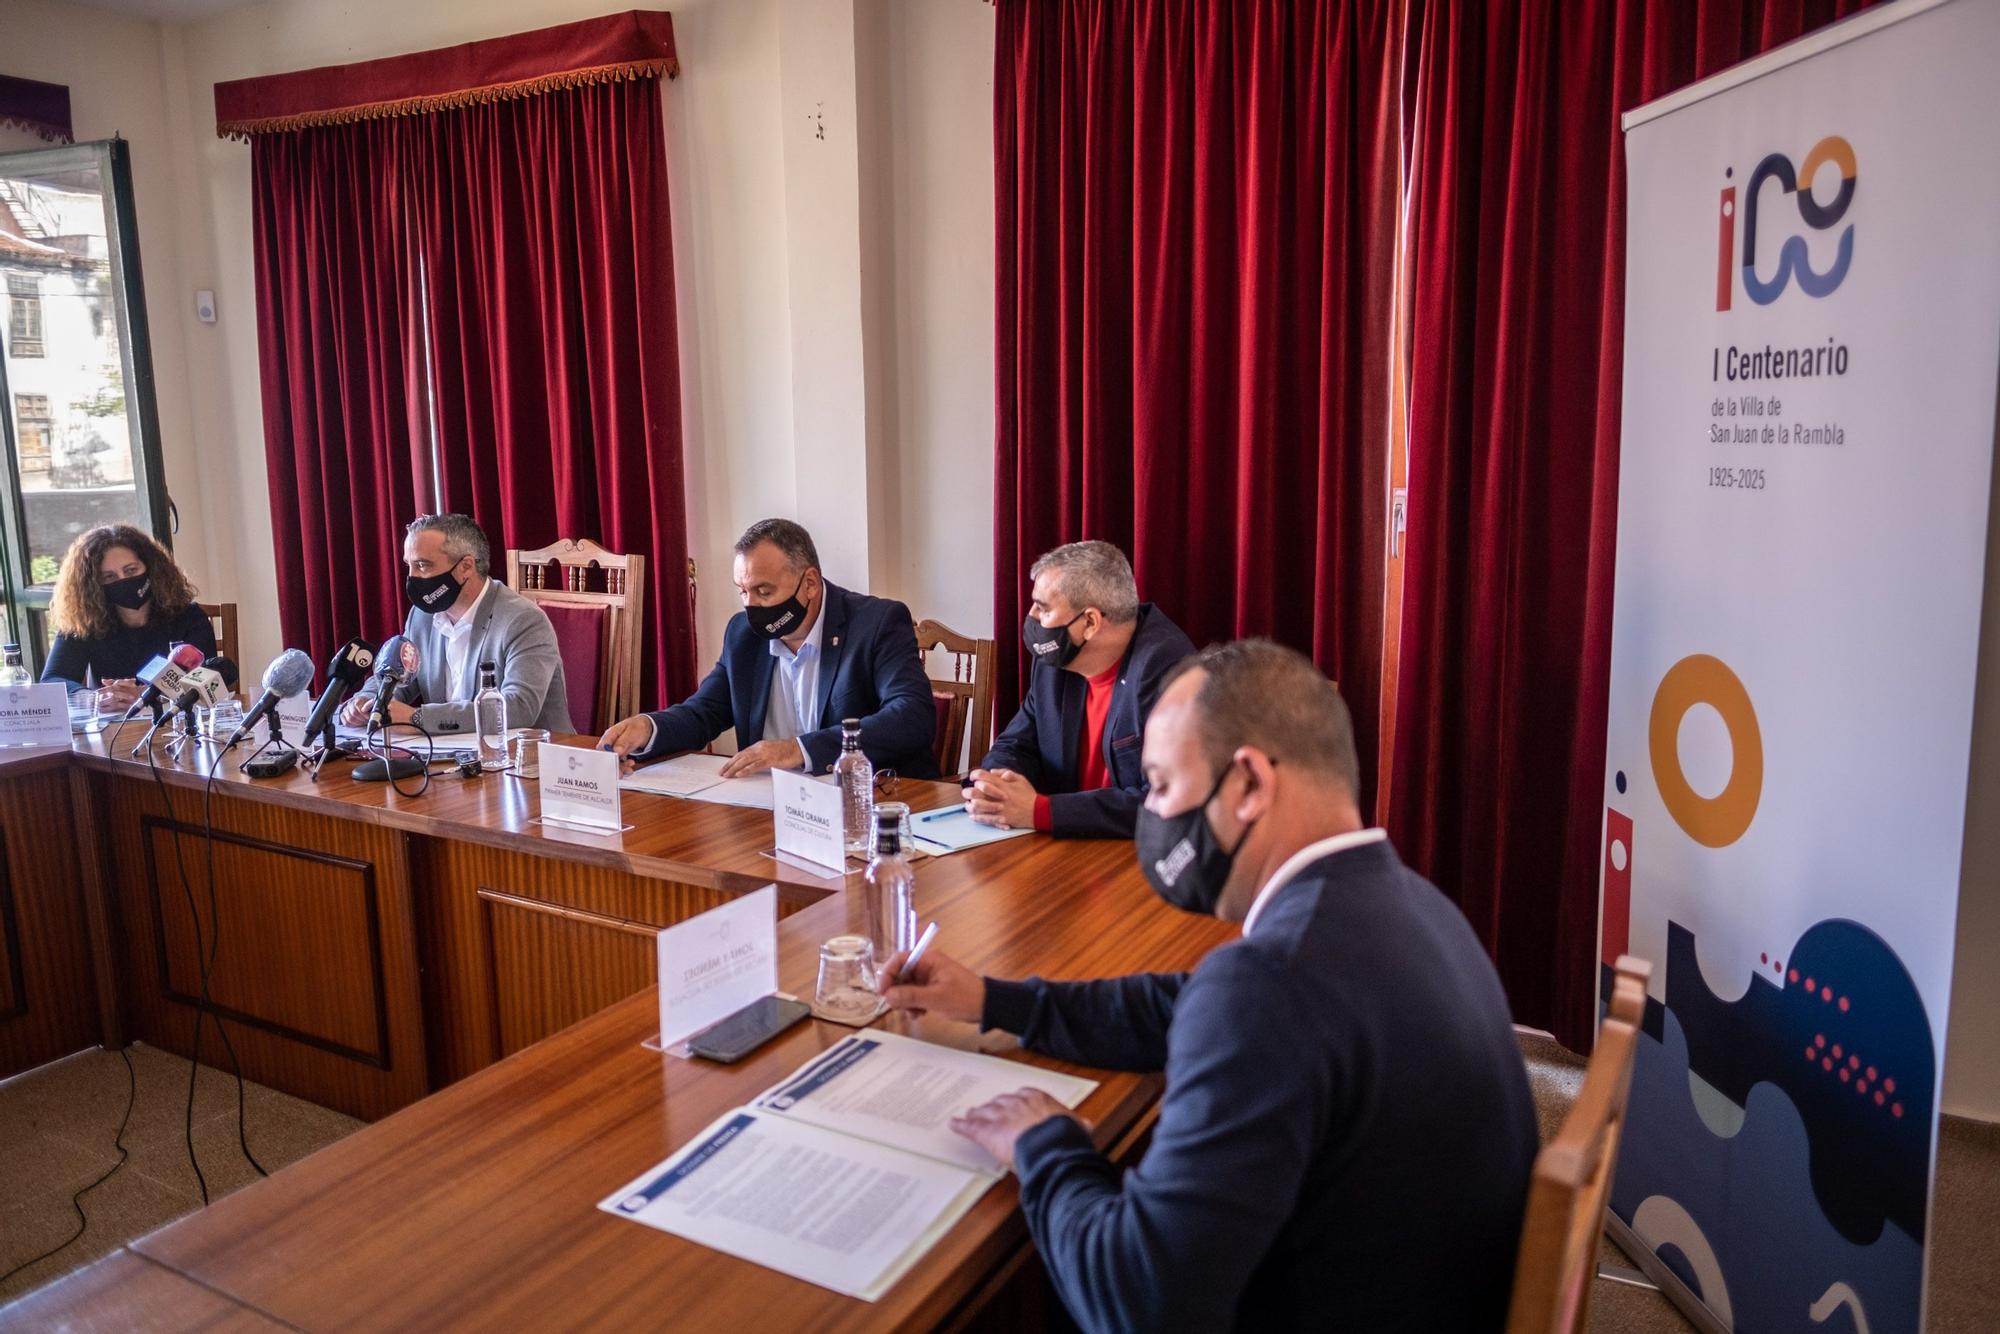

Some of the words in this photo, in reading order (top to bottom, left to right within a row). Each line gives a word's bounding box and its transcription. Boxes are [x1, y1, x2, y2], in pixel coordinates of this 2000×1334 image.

[1713, 347, 1719, 382] I
[1726, 336, 1848, 381] Centenario
[1711, 397, 1725, 417] de
[1727, 396, 1737, 416] la
[1740, 395, 1764, 416] Villa
[1767, 395, 1782, 416] de
[1711, 423, 1730, 443] San
[1732, 423, 1759, 444] Juan
[1761, 423, 1775, 444] de
[1778, 423, 1789, 444] la
[1793, 423, 1845, 445] Rambla
[1709, 467, 1766, 490] 1925-2025
[346, 642, 373, 668] 10
[161, 675, 180, 693] RADIO
[21, 708, 52, 716] MÉNDEZ
[279, 714, 308, 724] OMÍNGUEZ
[557, 777, 573, 786] JUAN
[575, 779, 598, 790] RAMOS
[785, 805, 805, 819] TOMÁS
[805, 812, 830, 827] ORAMAS
